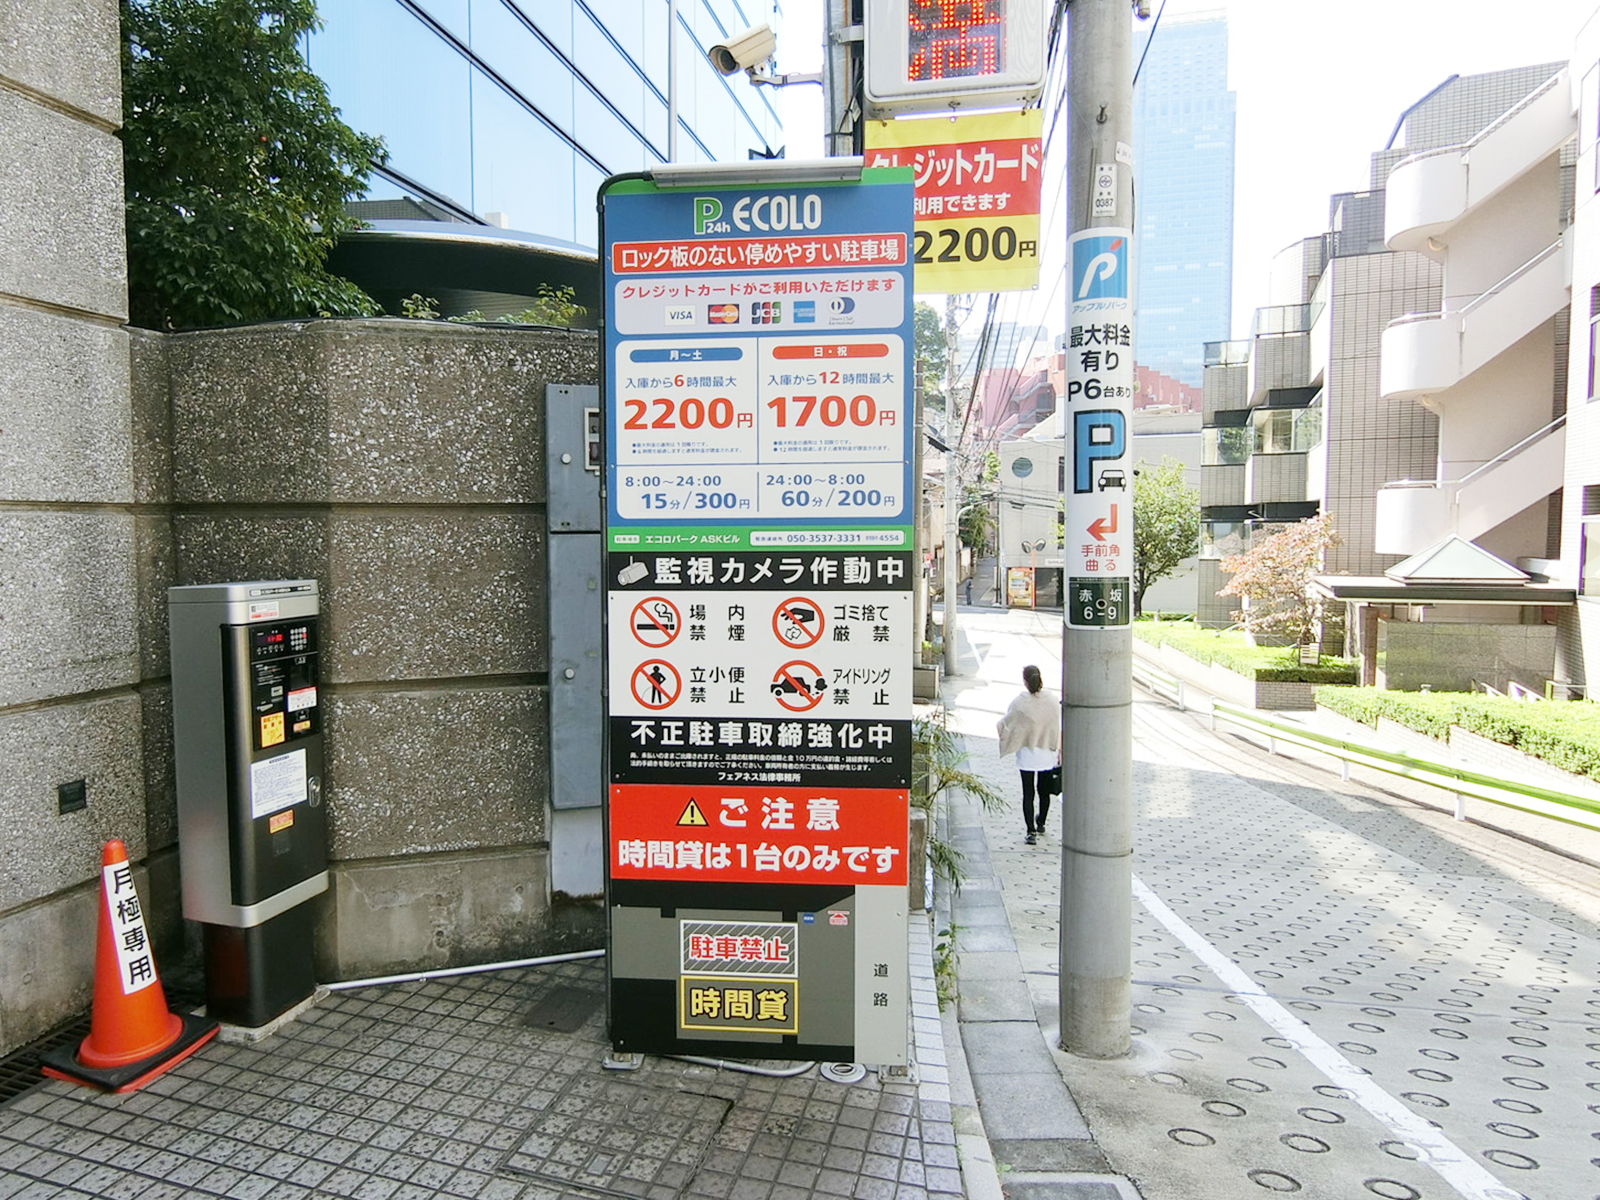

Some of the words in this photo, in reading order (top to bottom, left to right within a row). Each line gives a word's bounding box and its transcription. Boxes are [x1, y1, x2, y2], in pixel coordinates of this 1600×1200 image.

[706, 222, 731, 233] 24h
[733, 194, 822, 232] ECOLO
[1095, 198, 1113, 208] 0387
[622, 239, 899, 268] ロック板のない停めやすい駐車場
[622, 278, 896, 299] クレジットカードがご利用いただけます
[669, 310, 693, 321] VISA
[752, 309, 781, 318] JCB
[1070, 323, 1131, 348] 最大料金
[1080, 350, 1119, 373] 有り
[625, 374, 737, 389] 入庫から6時間最大
[767, 371, 894, 386] 入庫から12時間最大
[624, 397, 753, 430] 2200円
[767, 395, 896, 427] 1700円
[1074, 408, 1126, 494] P
[645, 534, 698, 544] エコロパーク
[700, 534, 740, 544] ASKビル
[787, 534, 861, 542] 050-3537-3331
[1081, 544, 1120, 557] 手前角
[654, 556, 904, 585] 監視カメラ作動中
[1086, 559, 1116, 571] 曲る
[1079, 589, 1122, 603] 赤坂
[833, 604, 890, 621] ゴミ捨て
[1084, 606, 1117, 620] 6-9
[690, 667, 745, 683] 立小便
[833, 668, 891, 685] アイドリング
[630, 720, 893, 749] 不正駐車取締強化中
[717, 771, 801, 782] フェアネス法律事務所
[719, 796, 840, 831] ご注意
[618, 839, 899, 873] 時間貸は1台のみです
[114, 866, 152, 986] 月極専用
[690, 936, 788, 963] 駐車禁止
[873, 963, 889, 1007] 道路
[690, 987, 788, 1021] 時間貸
